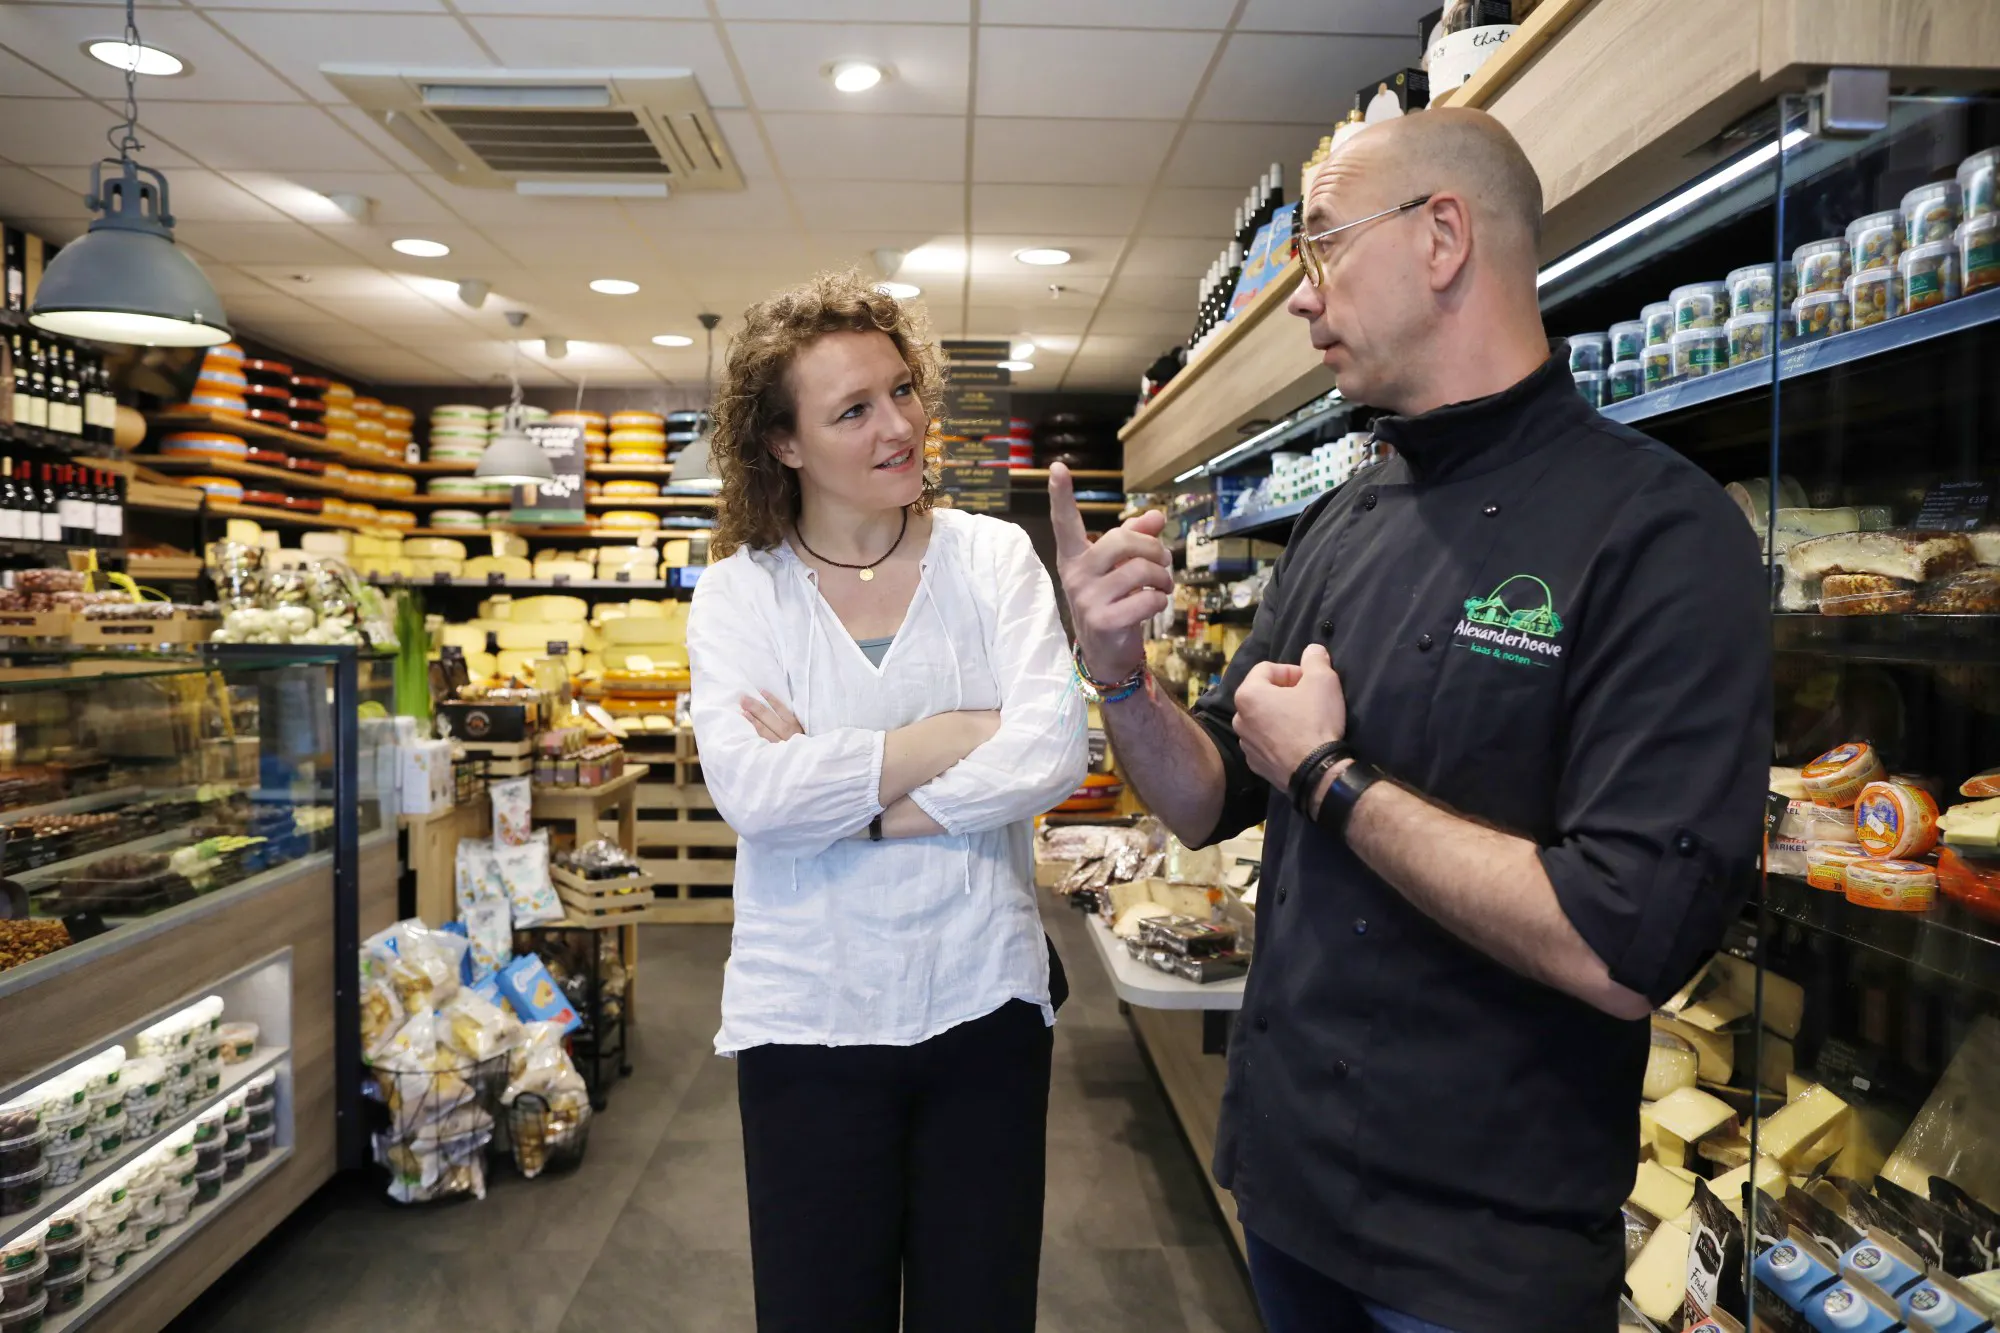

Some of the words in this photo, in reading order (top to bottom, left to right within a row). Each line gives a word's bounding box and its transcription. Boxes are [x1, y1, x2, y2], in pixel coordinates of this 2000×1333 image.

[1453, 619, 1562, 657] Alexanderhoeve
[1470, 642, 1491, 655] kaas
[1493, 648, 1501, 658] &
[1502, 652, 1531, 665] noten
